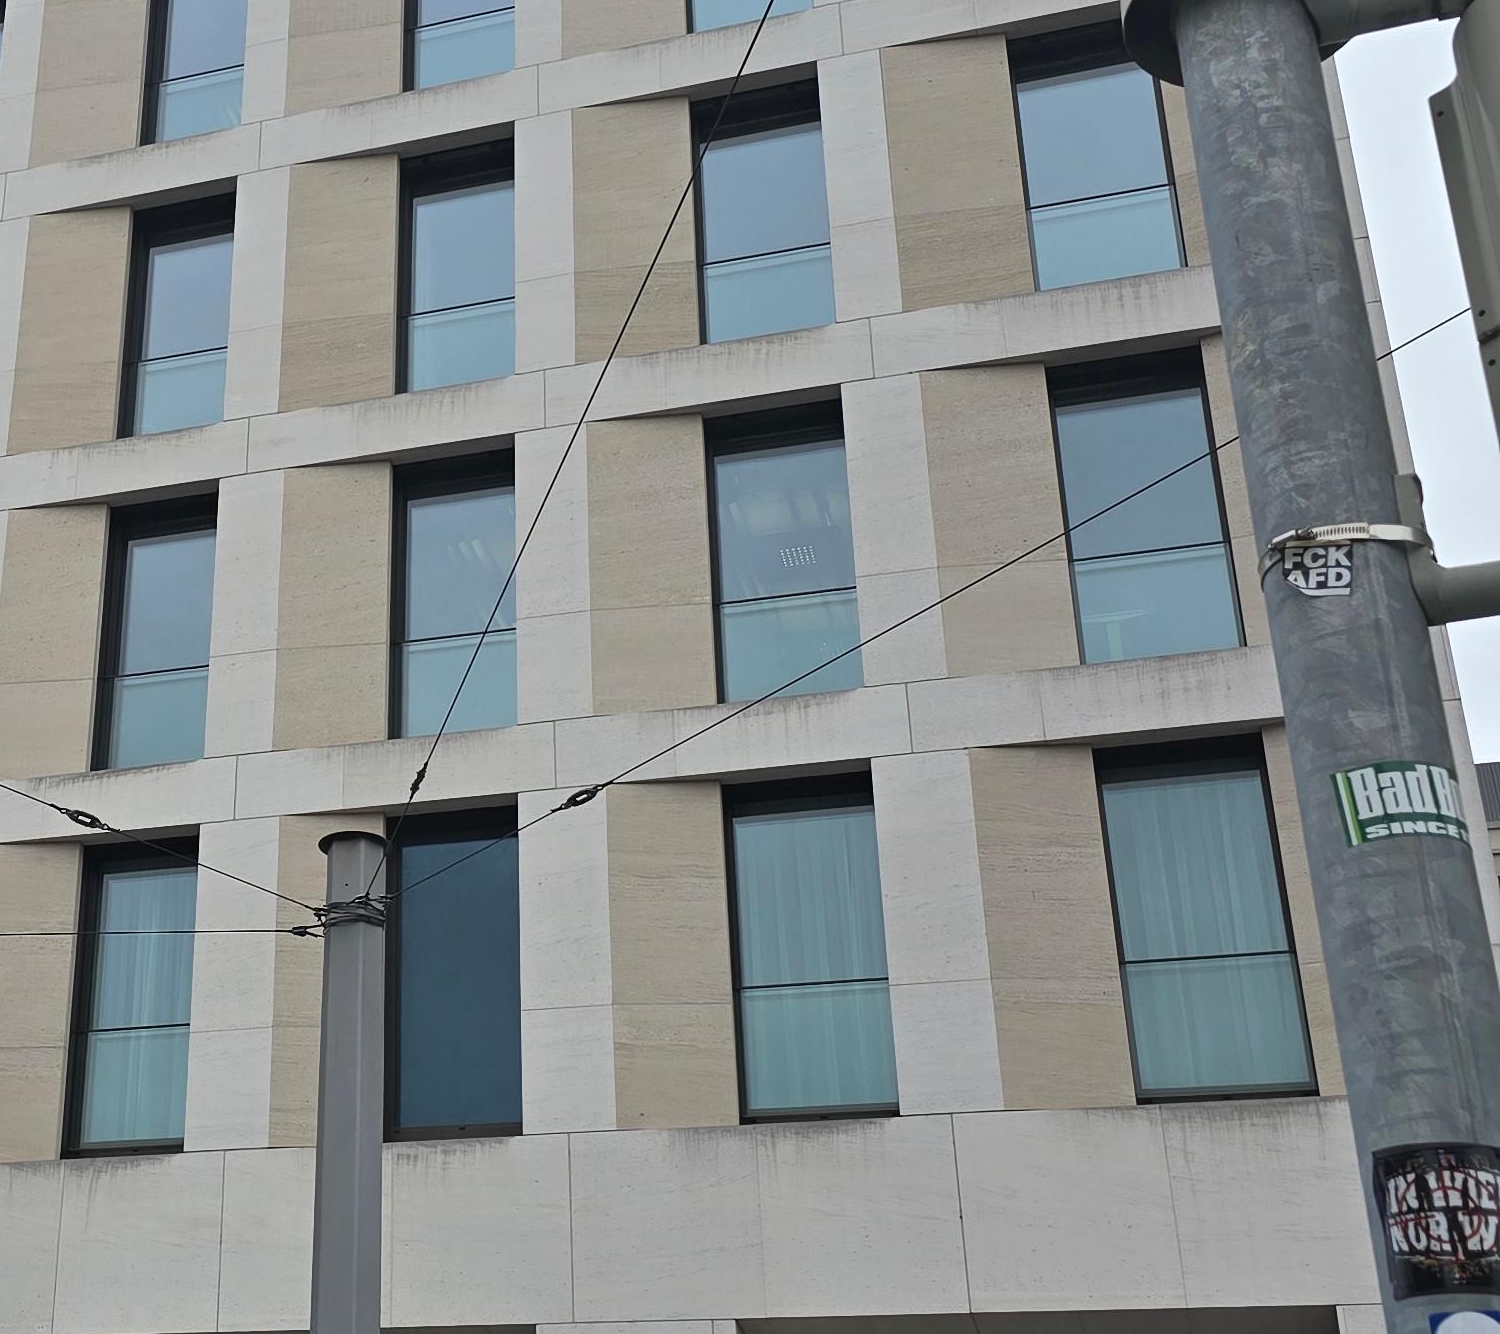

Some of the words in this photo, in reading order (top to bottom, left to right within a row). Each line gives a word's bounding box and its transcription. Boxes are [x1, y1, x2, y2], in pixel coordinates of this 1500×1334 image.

[1284, 546, 1351, 569] FCK
[1287, 567, 1351, 588] AFD
[1348, 764, 1438, 820] Bad
[1365, 821, 1459, 839] SINCE
[1424, 1169, 1500, 1210] WIE
